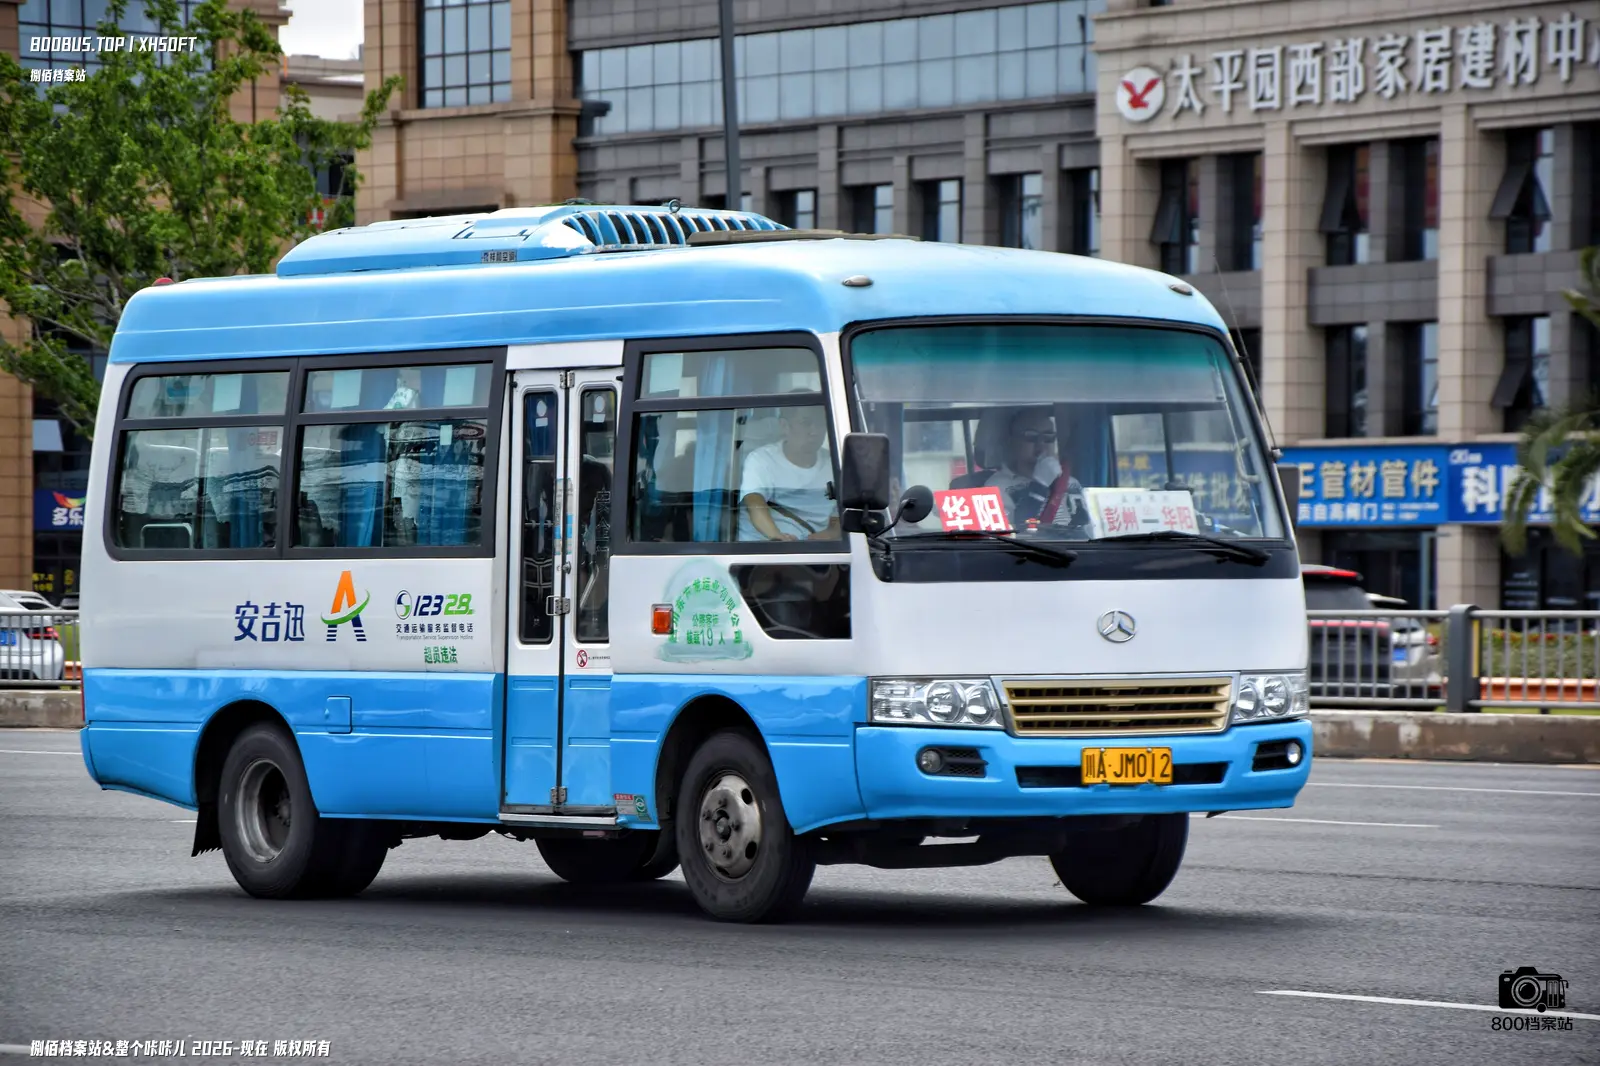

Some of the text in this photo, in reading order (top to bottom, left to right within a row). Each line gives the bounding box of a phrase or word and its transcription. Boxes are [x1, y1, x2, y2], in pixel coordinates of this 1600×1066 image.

[1171, 12, 1600, 118] 太平园西部家居建材中
[941, 494, 1007, 530] 华阳
[234, 600, 305, 642] 安吉迅
